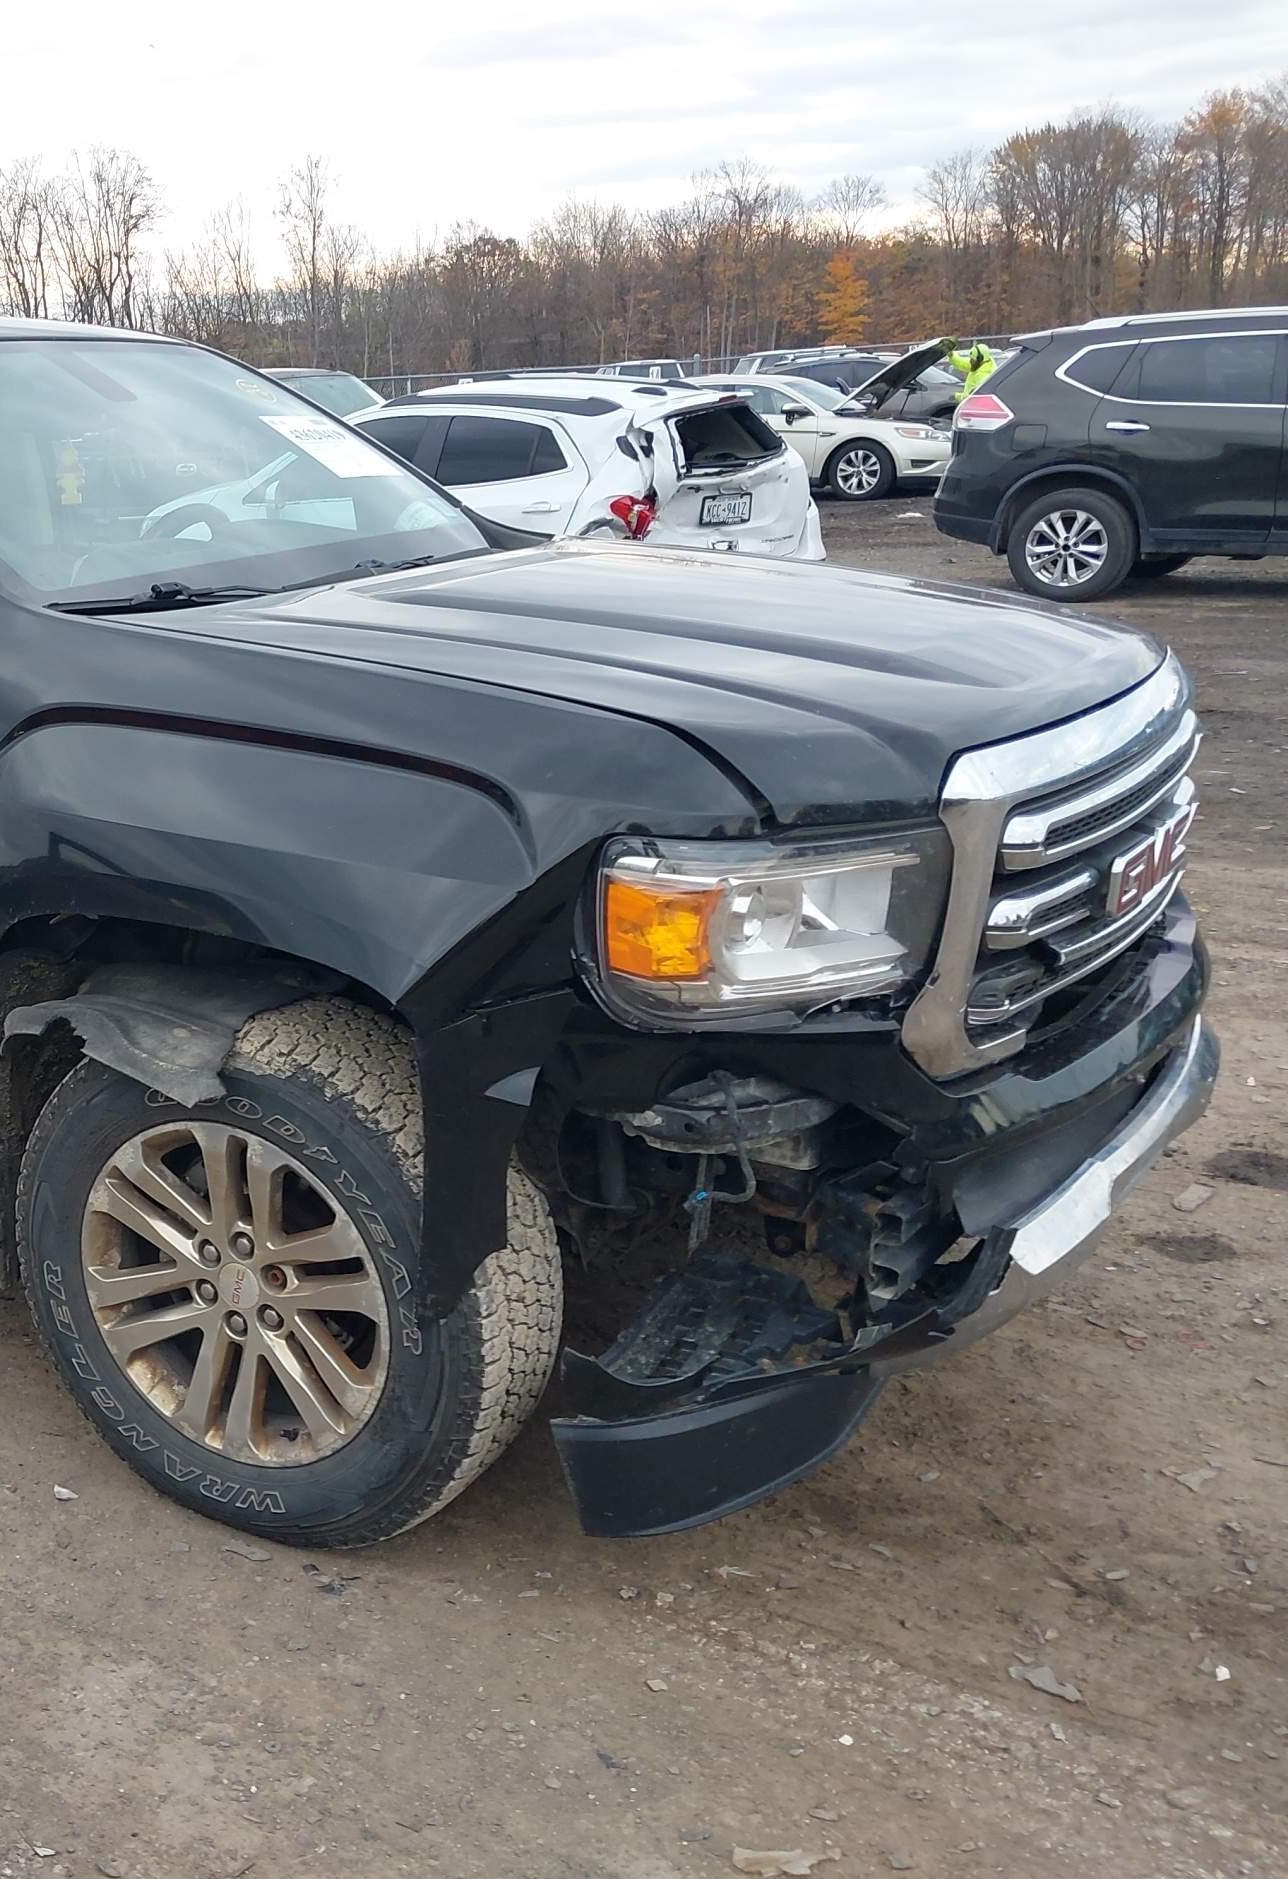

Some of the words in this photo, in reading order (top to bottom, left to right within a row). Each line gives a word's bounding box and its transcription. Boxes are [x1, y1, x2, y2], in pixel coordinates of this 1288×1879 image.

[1107, 803, 1200, 917] GMC
[232, 1269, 246, 1305] GMC
[43, 1259, 287, 1514] WRANGLER
